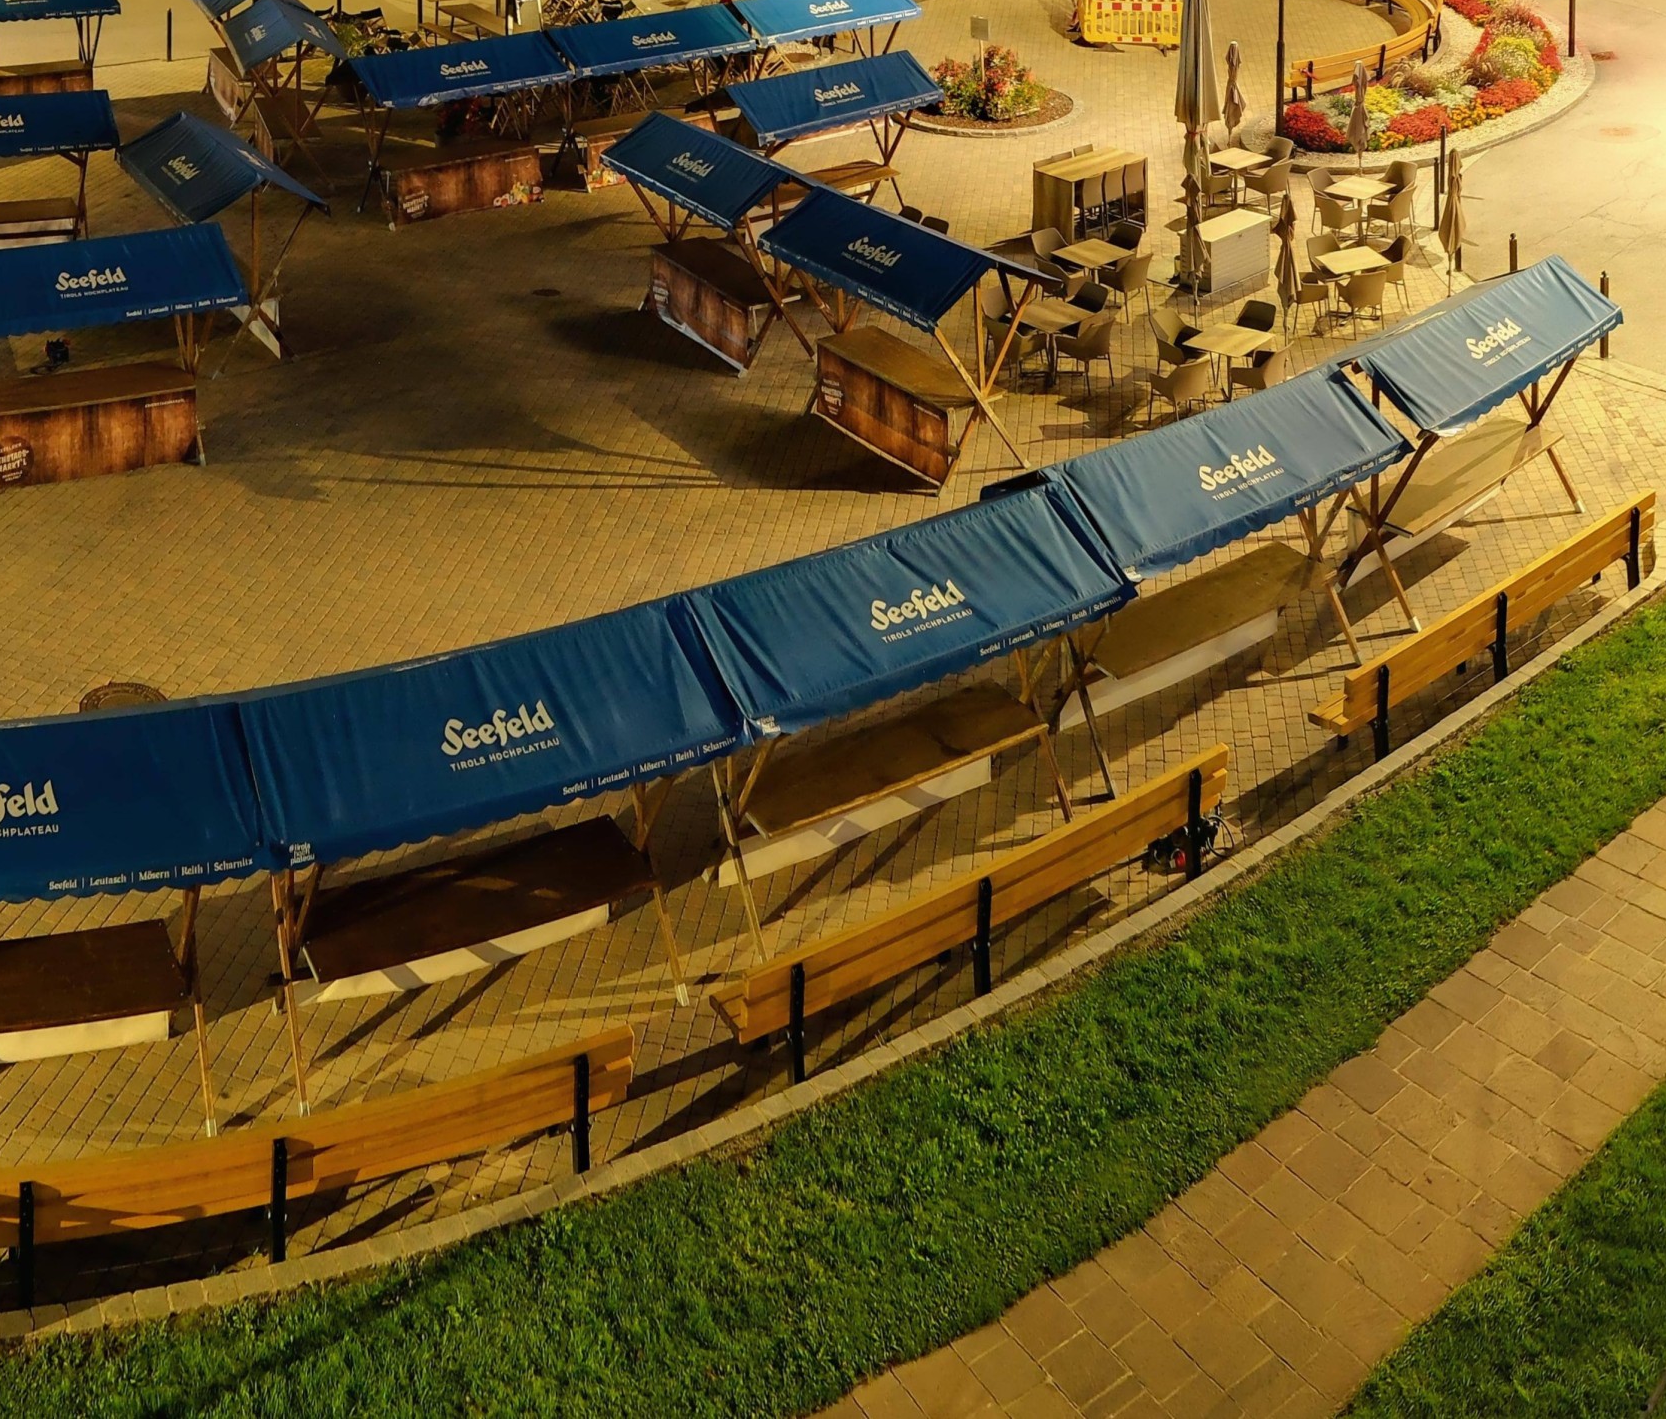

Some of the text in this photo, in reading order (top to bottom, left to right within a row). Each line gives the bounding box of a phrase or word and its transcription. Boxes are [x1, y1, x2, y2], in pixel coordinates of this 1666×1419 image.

[809, 0, 850, 15] Seefeld
[632, 31, 676, 46] Seefeld
[440, 59, 488, 75] Seefeld
[814, 82, 861, 102] Seefeld
[672, 152, 715, 178] Seefeld
[847, 236, 902, 267] Seefeld
[55, 266, 127, 291] Seefeld
[1466, 317, 1522, 360] Seefeld
[1199, 444, 1277, 492] Seefeld
[1212, 467, 1285, 502] TIROLS HOCHPLATEAU
[870, 579, 965, 631] Seefeld
[881, 608, 973, 644] TIROLS HOCHPLATEAU
[441, 699, 556, 756] Seefeld
[449, 737, 561, 772] TIROLS HOCHPLATEAU
[562, 736, 737, 796] Seefeld Leutasch Mösern Reith Scharnitz
[49, 857, 254, 891] Seefeld Leutasch Mösern Reith Scharnitz
